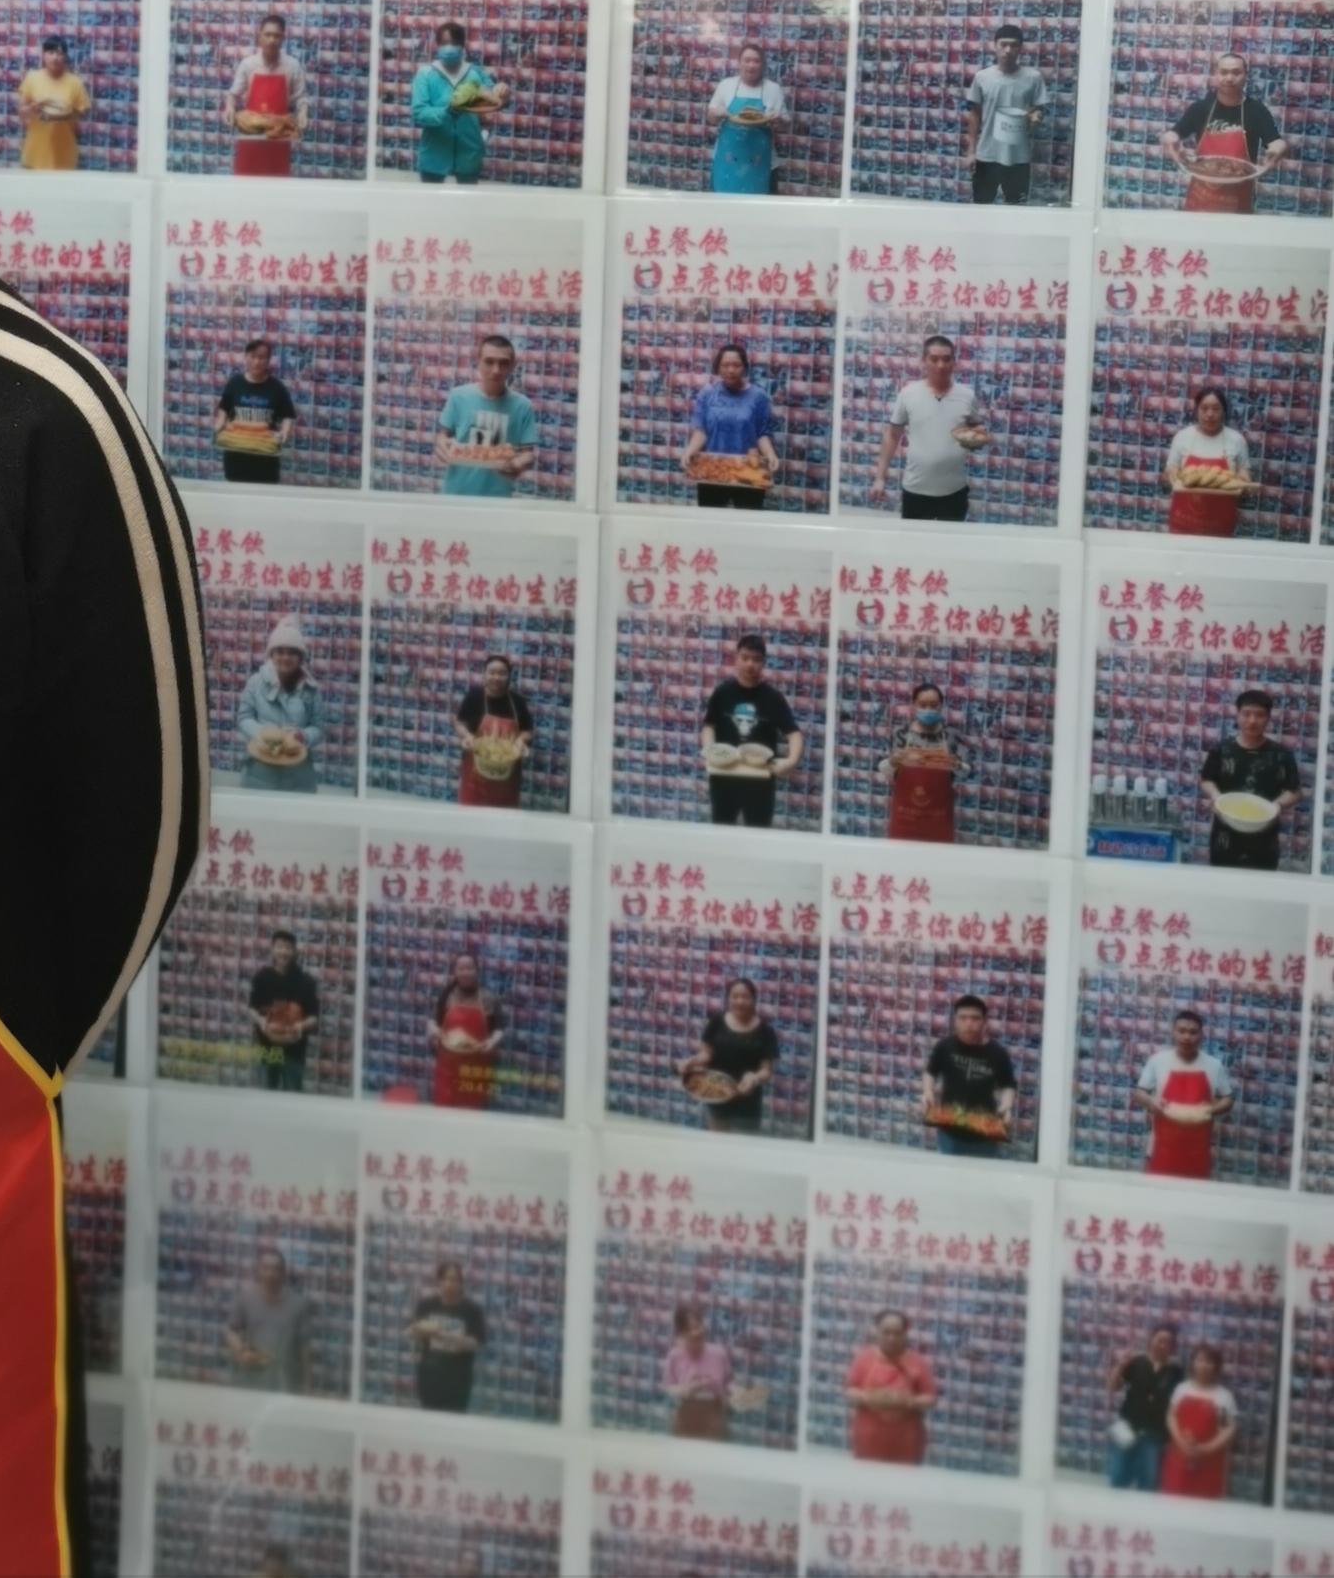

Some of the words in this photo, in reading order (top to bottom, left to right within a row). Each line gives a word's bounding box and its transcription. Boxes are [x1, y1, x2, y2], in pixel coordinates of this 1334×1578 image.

[209, 251, 368, 285] 点亮你的生活
[418, 268, 583, 300] 点亮你的生活
[214, 558, 363, 591] 点亮你的生活
[416, 571, 577, 605] 点亮你的生活
[1141, 620, 1326, 655] 点亮你的生活
[411, 877, 570, 911] 点亮你的生活
[650, 898, 819, 933] 点亮你的生活
[872, 910, 1048, 945] 点亮你的生活
[1128, 945, 1306, 983] 点亮你的生活
[1106, 1254, 1277, 1293] 点亮你的生活
